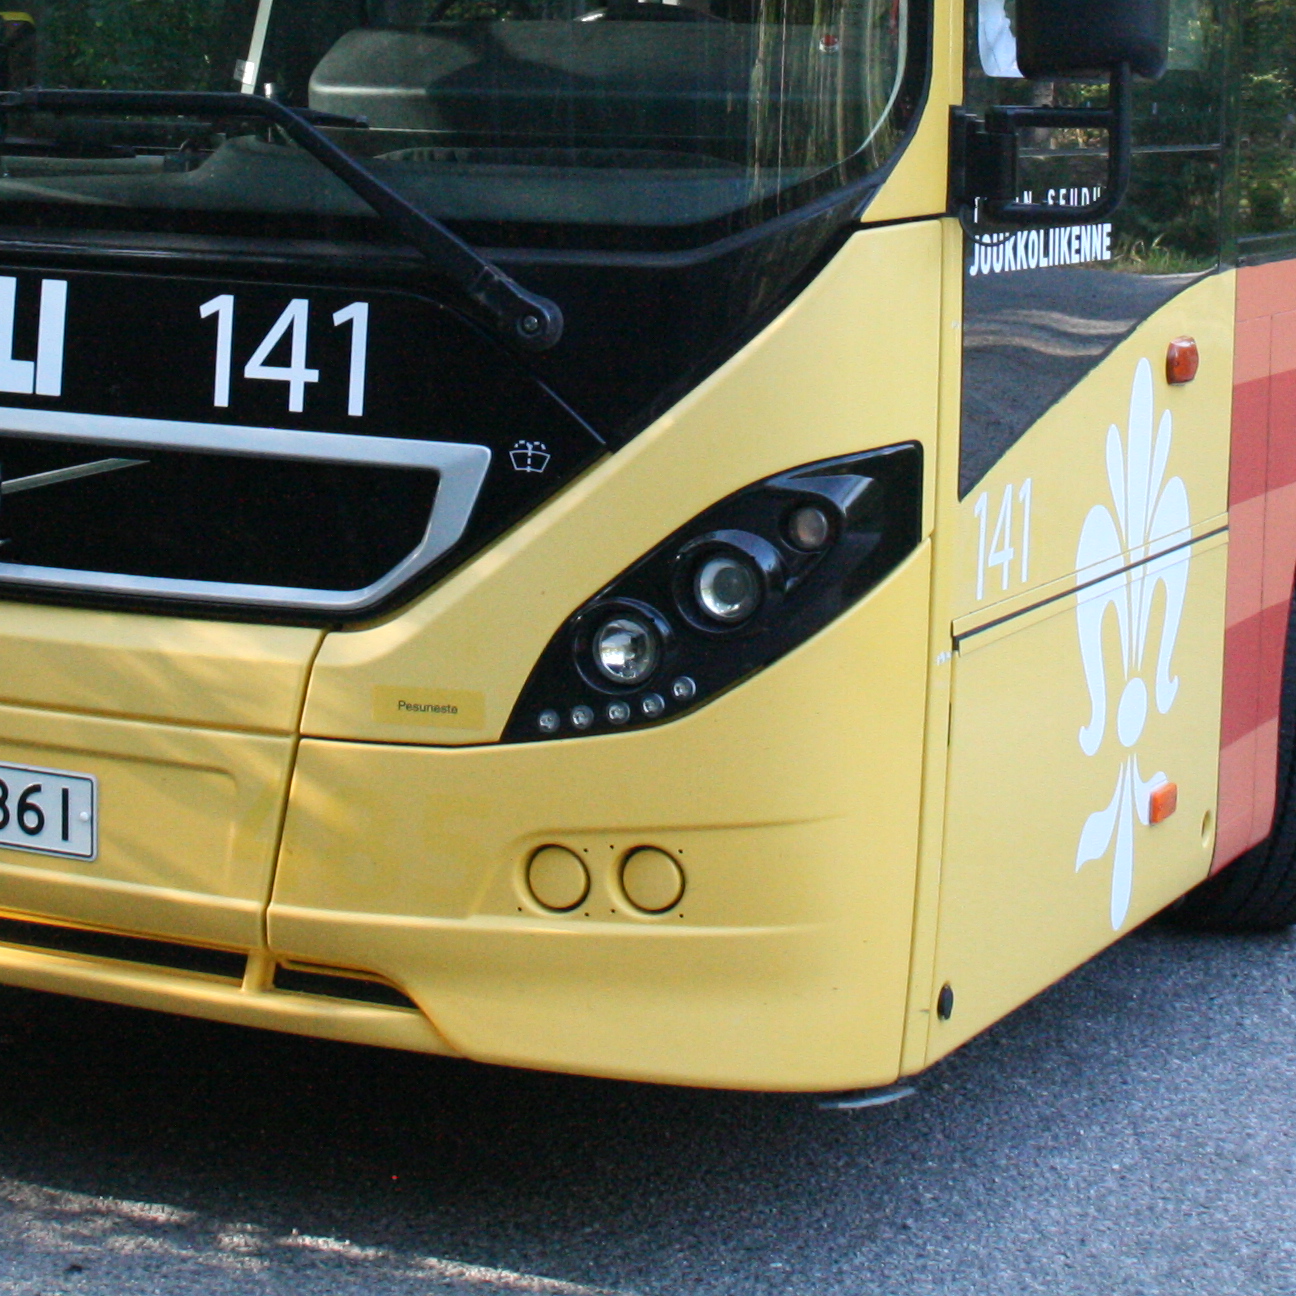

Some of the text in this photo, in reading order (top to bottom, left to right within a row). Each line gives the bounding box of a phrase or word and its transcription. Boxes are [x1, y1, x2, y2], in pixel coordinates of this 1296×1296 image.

[969, 223, 1112, 276] JOUKKOLIIKENNE
[198, 293, 370, 417] 141
[974, 477, 1032, 600] 141
[397, 699, 458, 715] Pesuneste
